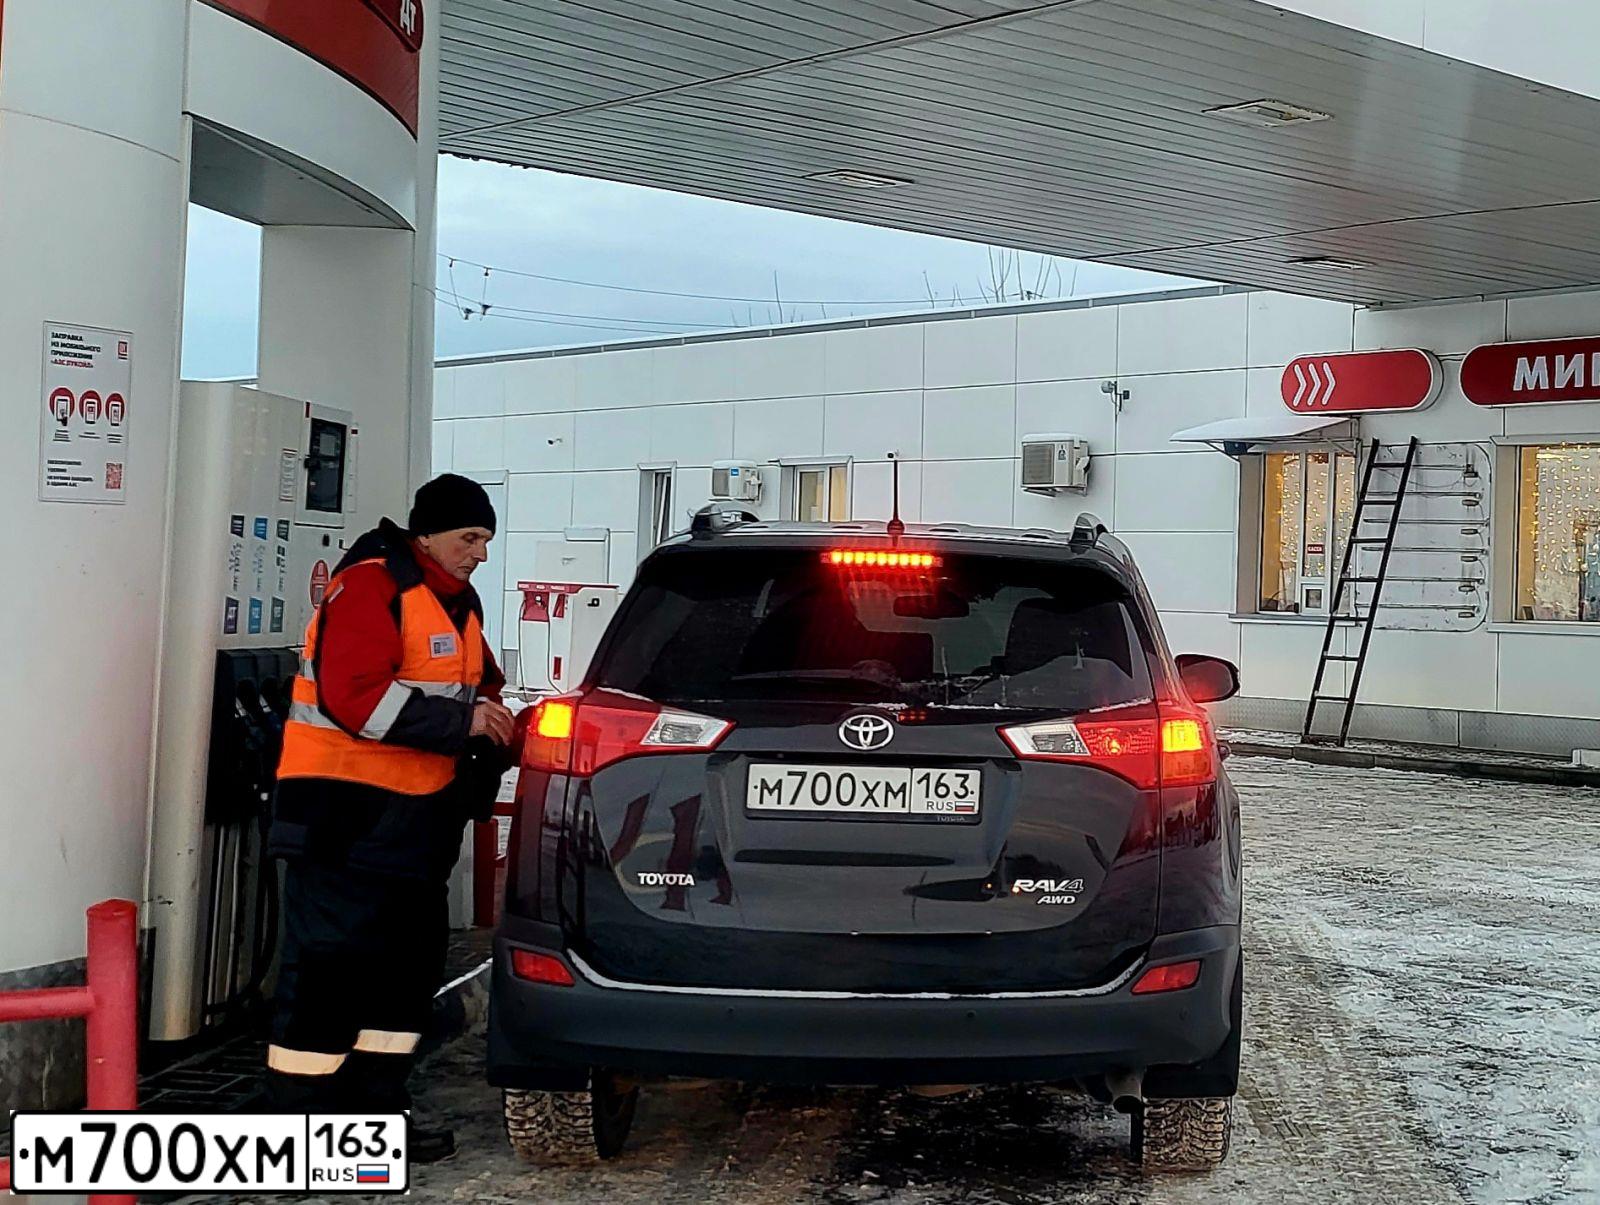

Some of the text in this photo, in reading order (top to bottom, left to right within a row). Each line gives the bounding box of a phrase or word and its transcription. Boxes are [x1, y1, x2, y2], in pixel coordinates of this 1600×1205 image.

[1513, 352, 1600, 391] МИ
[916, 772, 970, 799] 163
[926, 801, 954, 811] RUS
[637, 872, 695, 886] TOYOTA
[1012, 879, 1084, 893] RAV4
[1037, 895, 1076, 904] AWD
